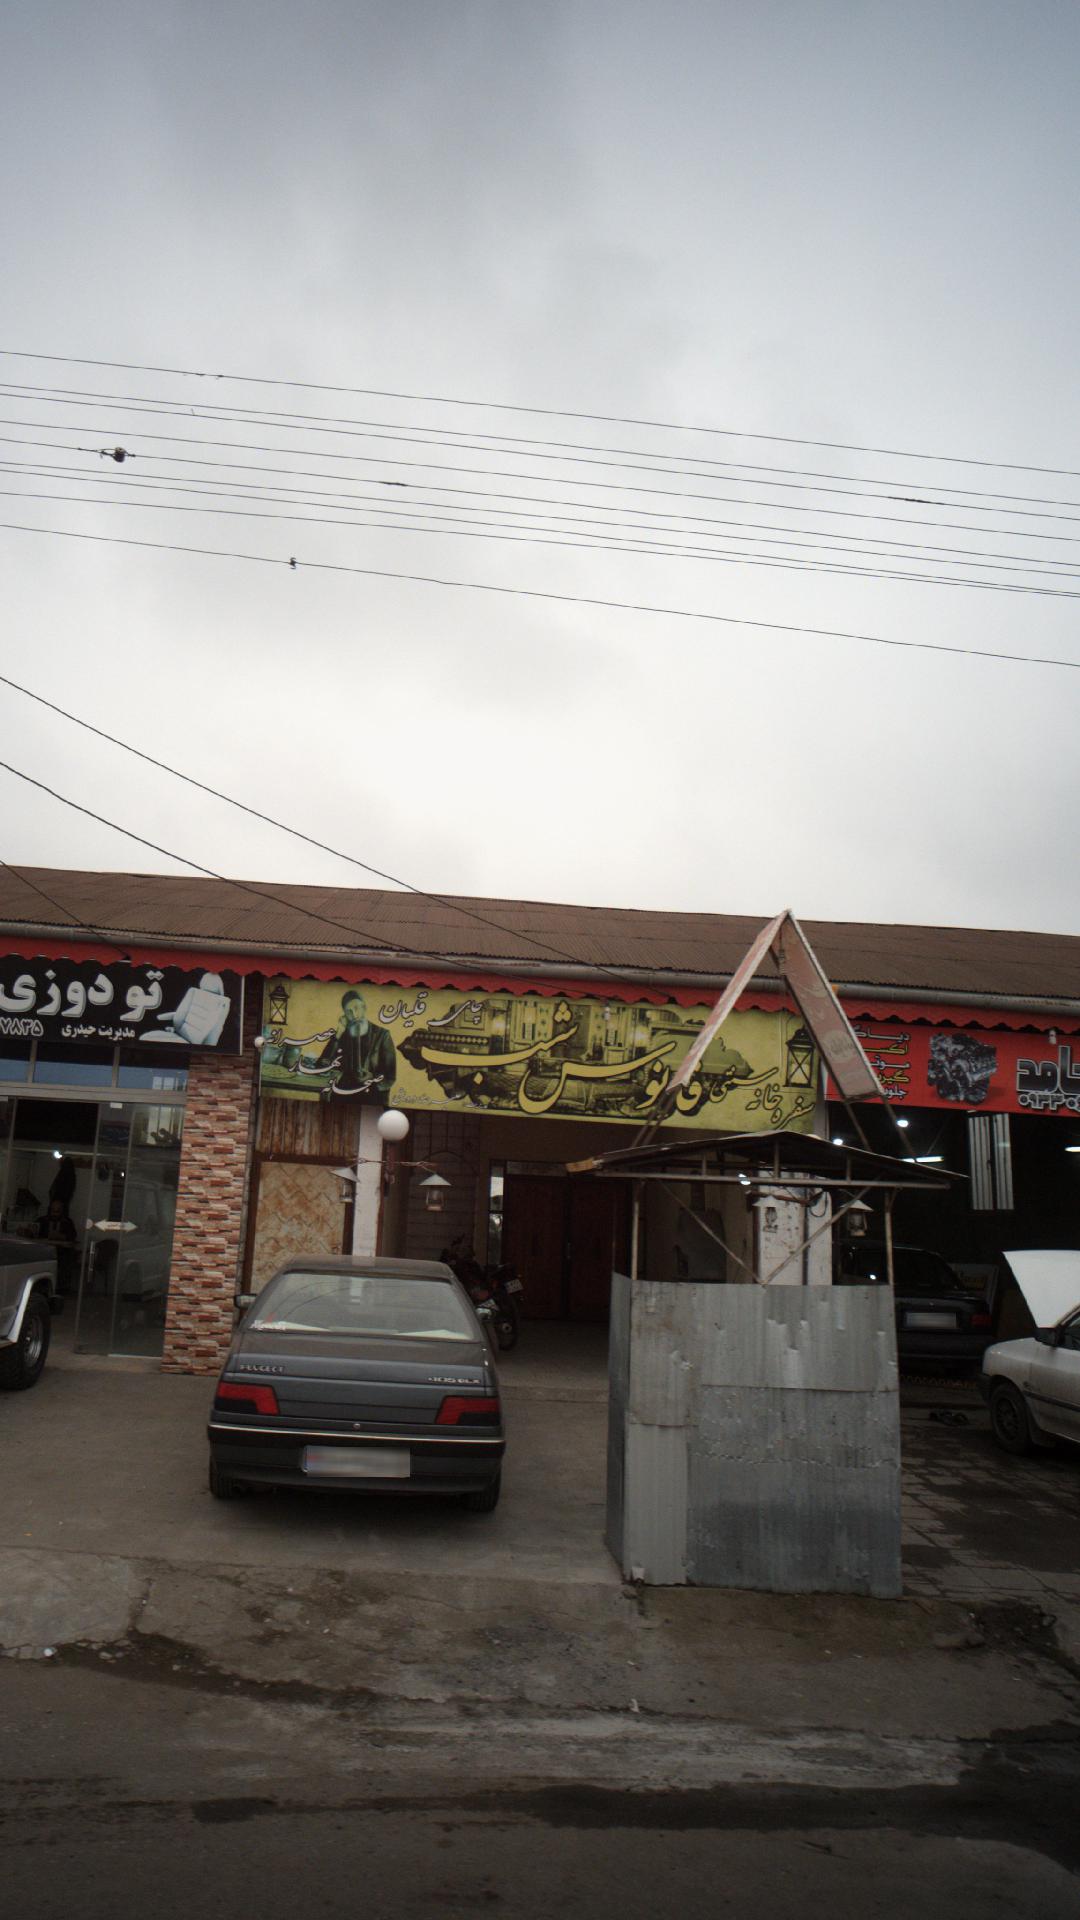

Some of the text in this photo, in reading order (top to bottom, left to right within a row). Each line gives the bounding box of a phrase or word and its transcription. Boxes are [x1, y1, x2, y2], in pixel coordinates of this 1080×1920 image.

[378, 990, 484, 1028] چای قلیان
[61, 1023, 136, 1041] مدیریت حیدری
[264, 1027, 336, 1050] عصرانه
[287, 1047, 344, 1075] نهار
[709, 1064, 779, 1103] سنتی
[744, 1082, 785, 1111] خانه
